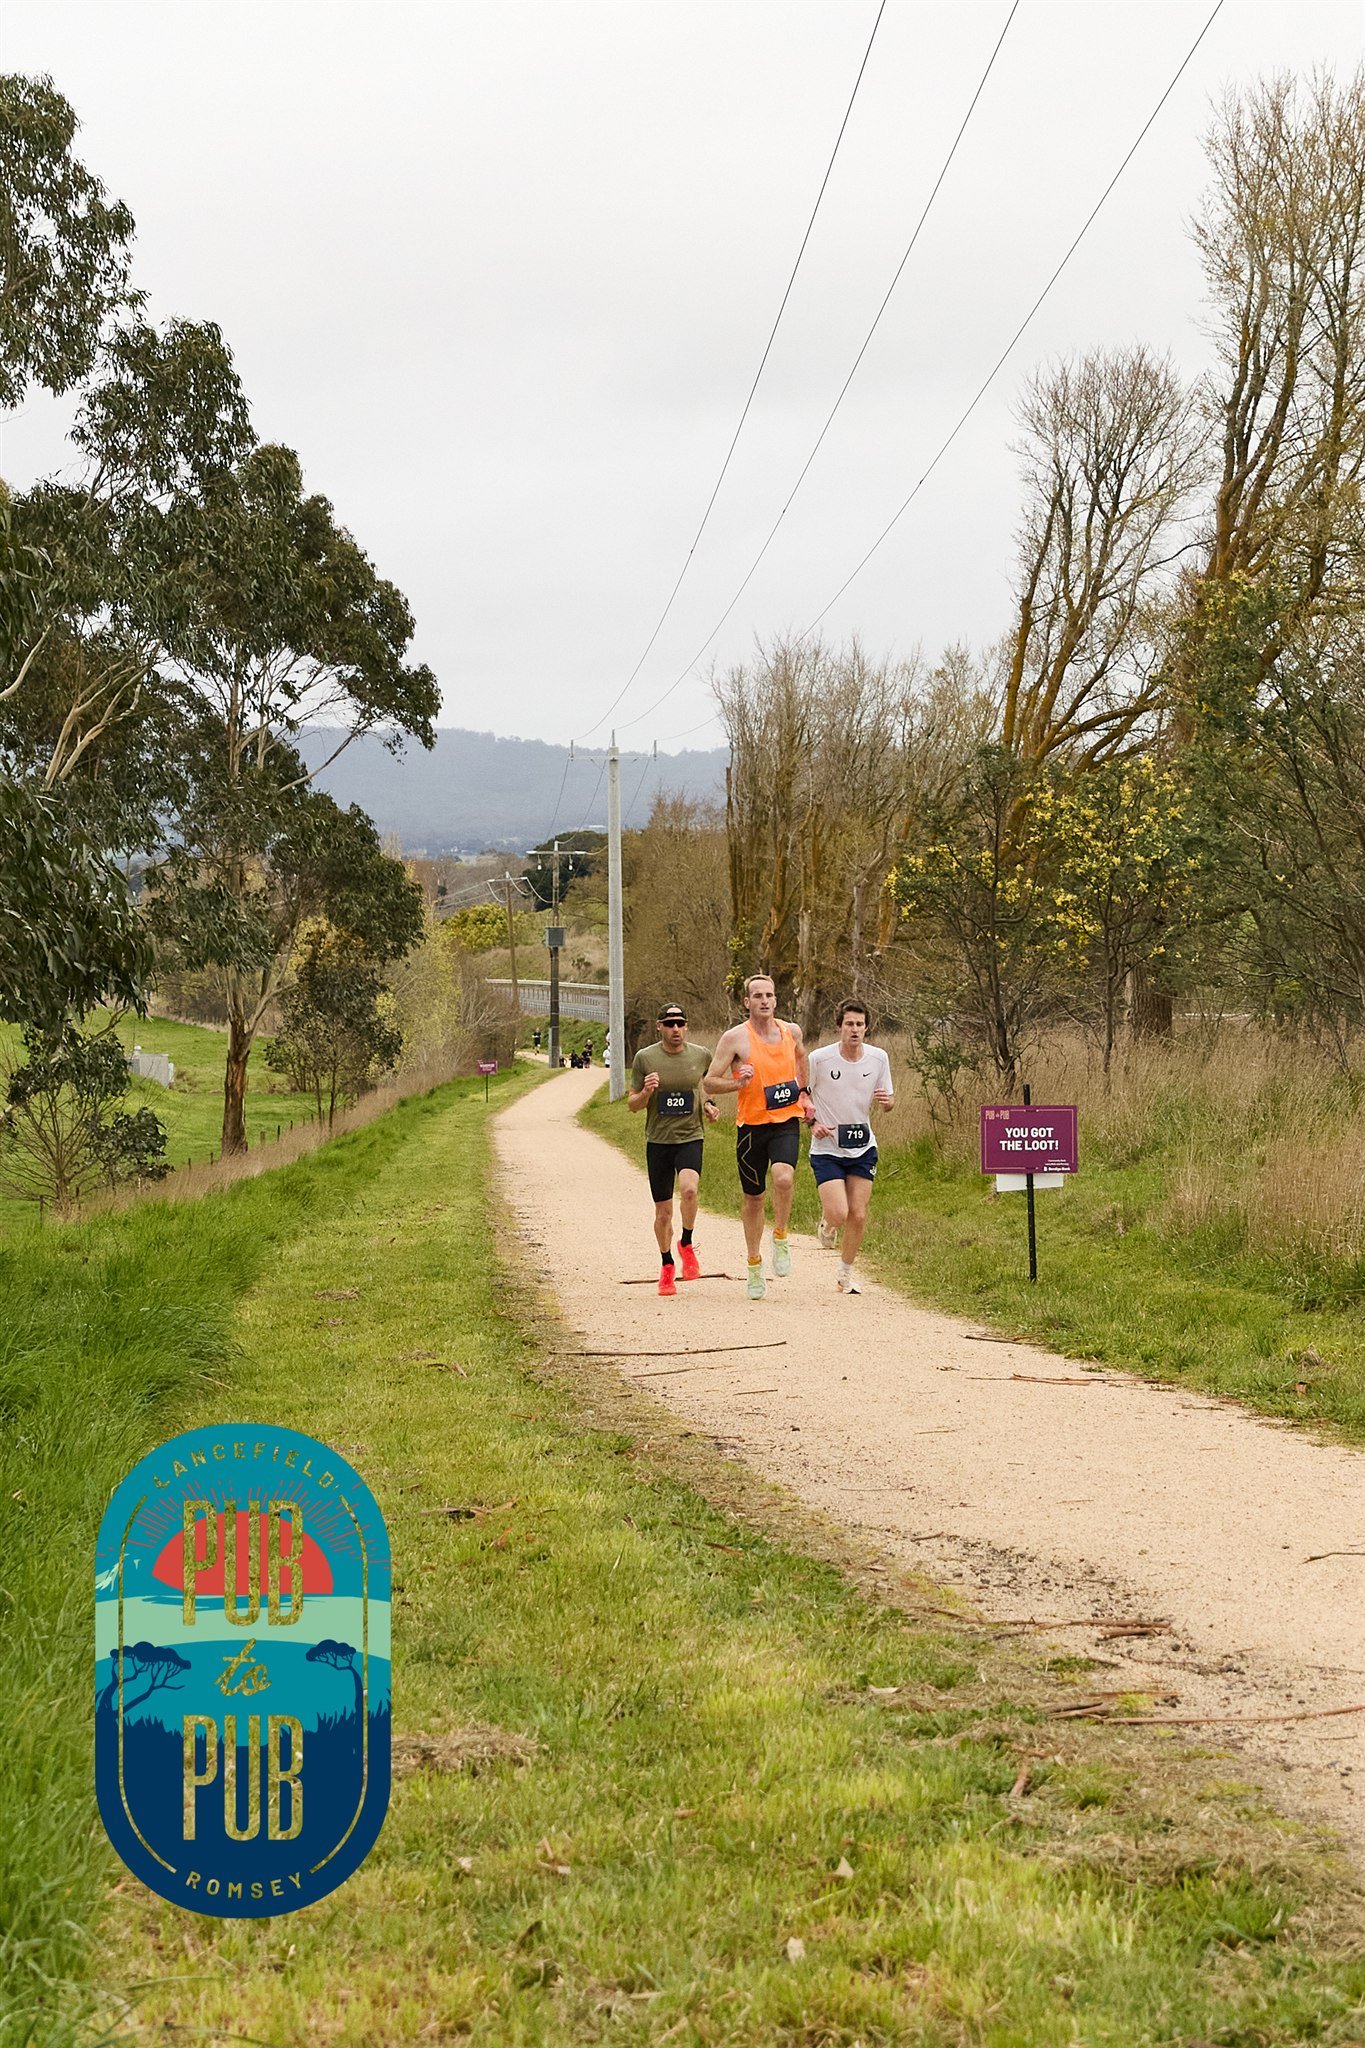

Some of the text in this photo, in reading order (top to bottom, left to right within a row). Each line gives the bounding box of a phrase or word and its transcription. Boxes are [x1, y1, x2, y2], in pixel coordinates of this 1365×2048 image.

[774, 1088, 791, 1100] 449
[666, 1097, 685, 1107] 820
[985, 1109, 995, 1120] PUB
[1000, 1109, 1010, 1120] PUB
[847, 1130, 864, 1139] 719
[1005, 1127, 1054, 1138] YOU GOT
[999, 1140, 1059, 1151] THE LOOT!
